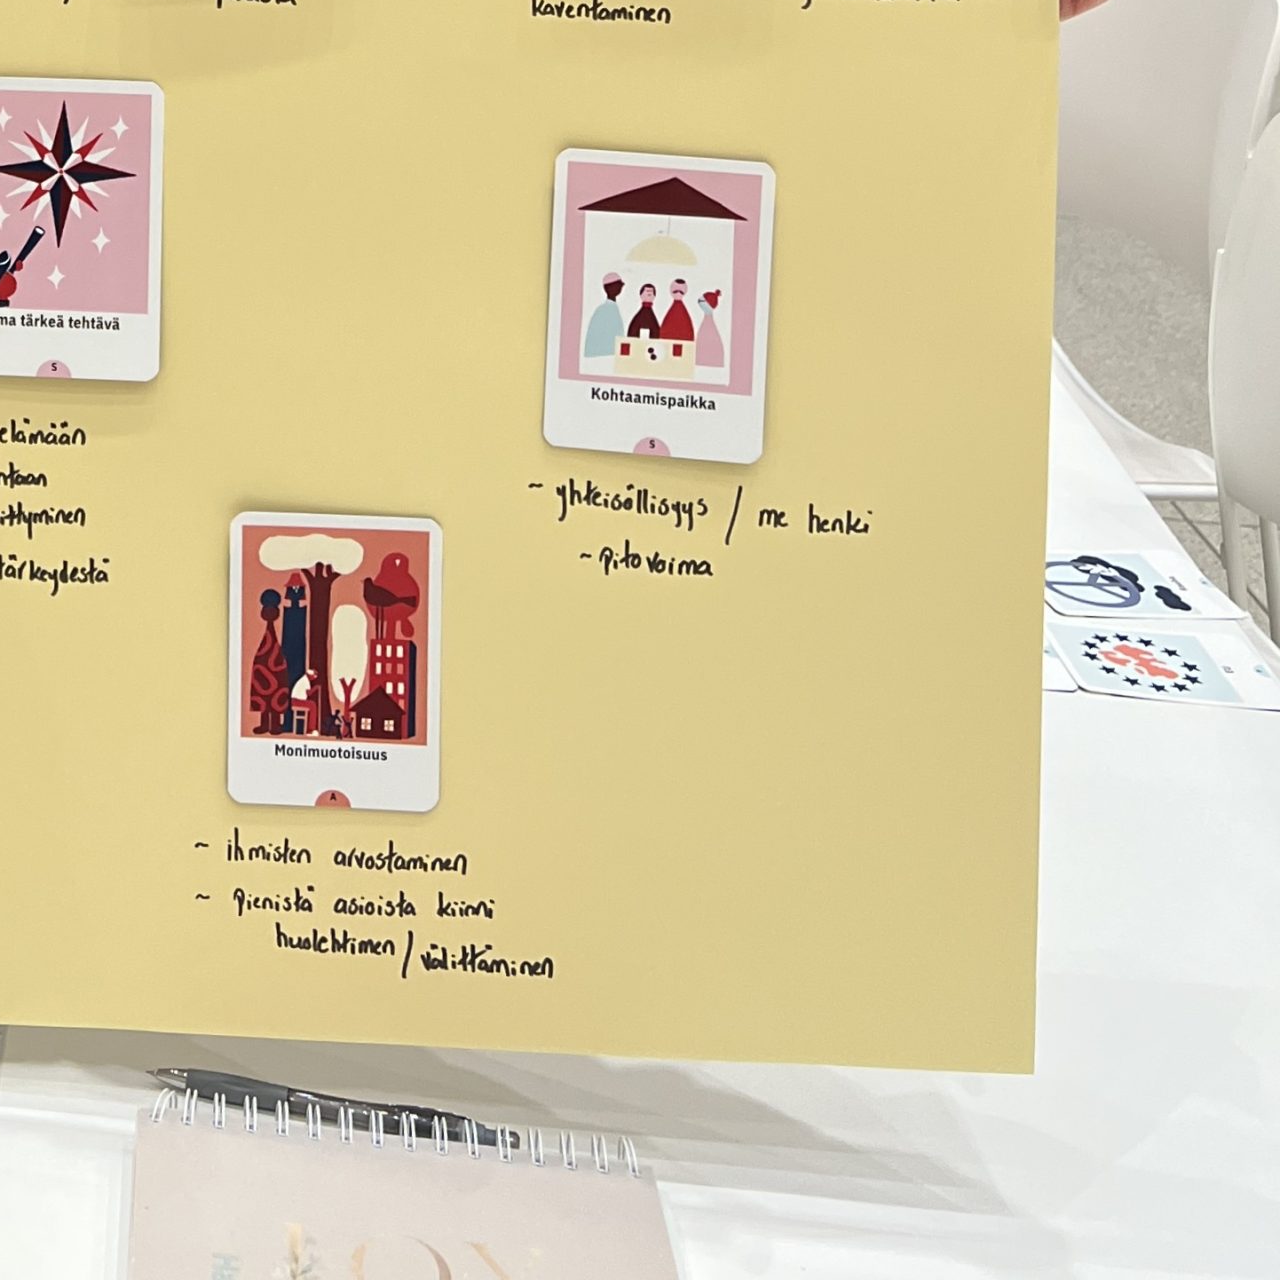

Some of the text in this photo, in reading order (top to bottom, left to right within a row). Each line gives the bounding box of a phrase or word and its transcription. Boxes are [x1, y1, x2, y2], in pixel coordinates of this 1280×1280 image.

[20, 314, 64, 328] tärkeä
[68, 316, 120, 331] tehtävä
[591, 387, 716, 410] Kohtaamispaikka
[556, 478, 708, 531] yhteisöllisyys
[758, 509, 788, 528] me
[808, 503, 873, 535] henki
[274, 744, 388, 761] Monimuotoisuus
[329, 792, 337, 801] A
[227, 827, 467, 875] ihmisten arvostaminen
[233, 885, 495, 919] pienistä asioista kiinni
